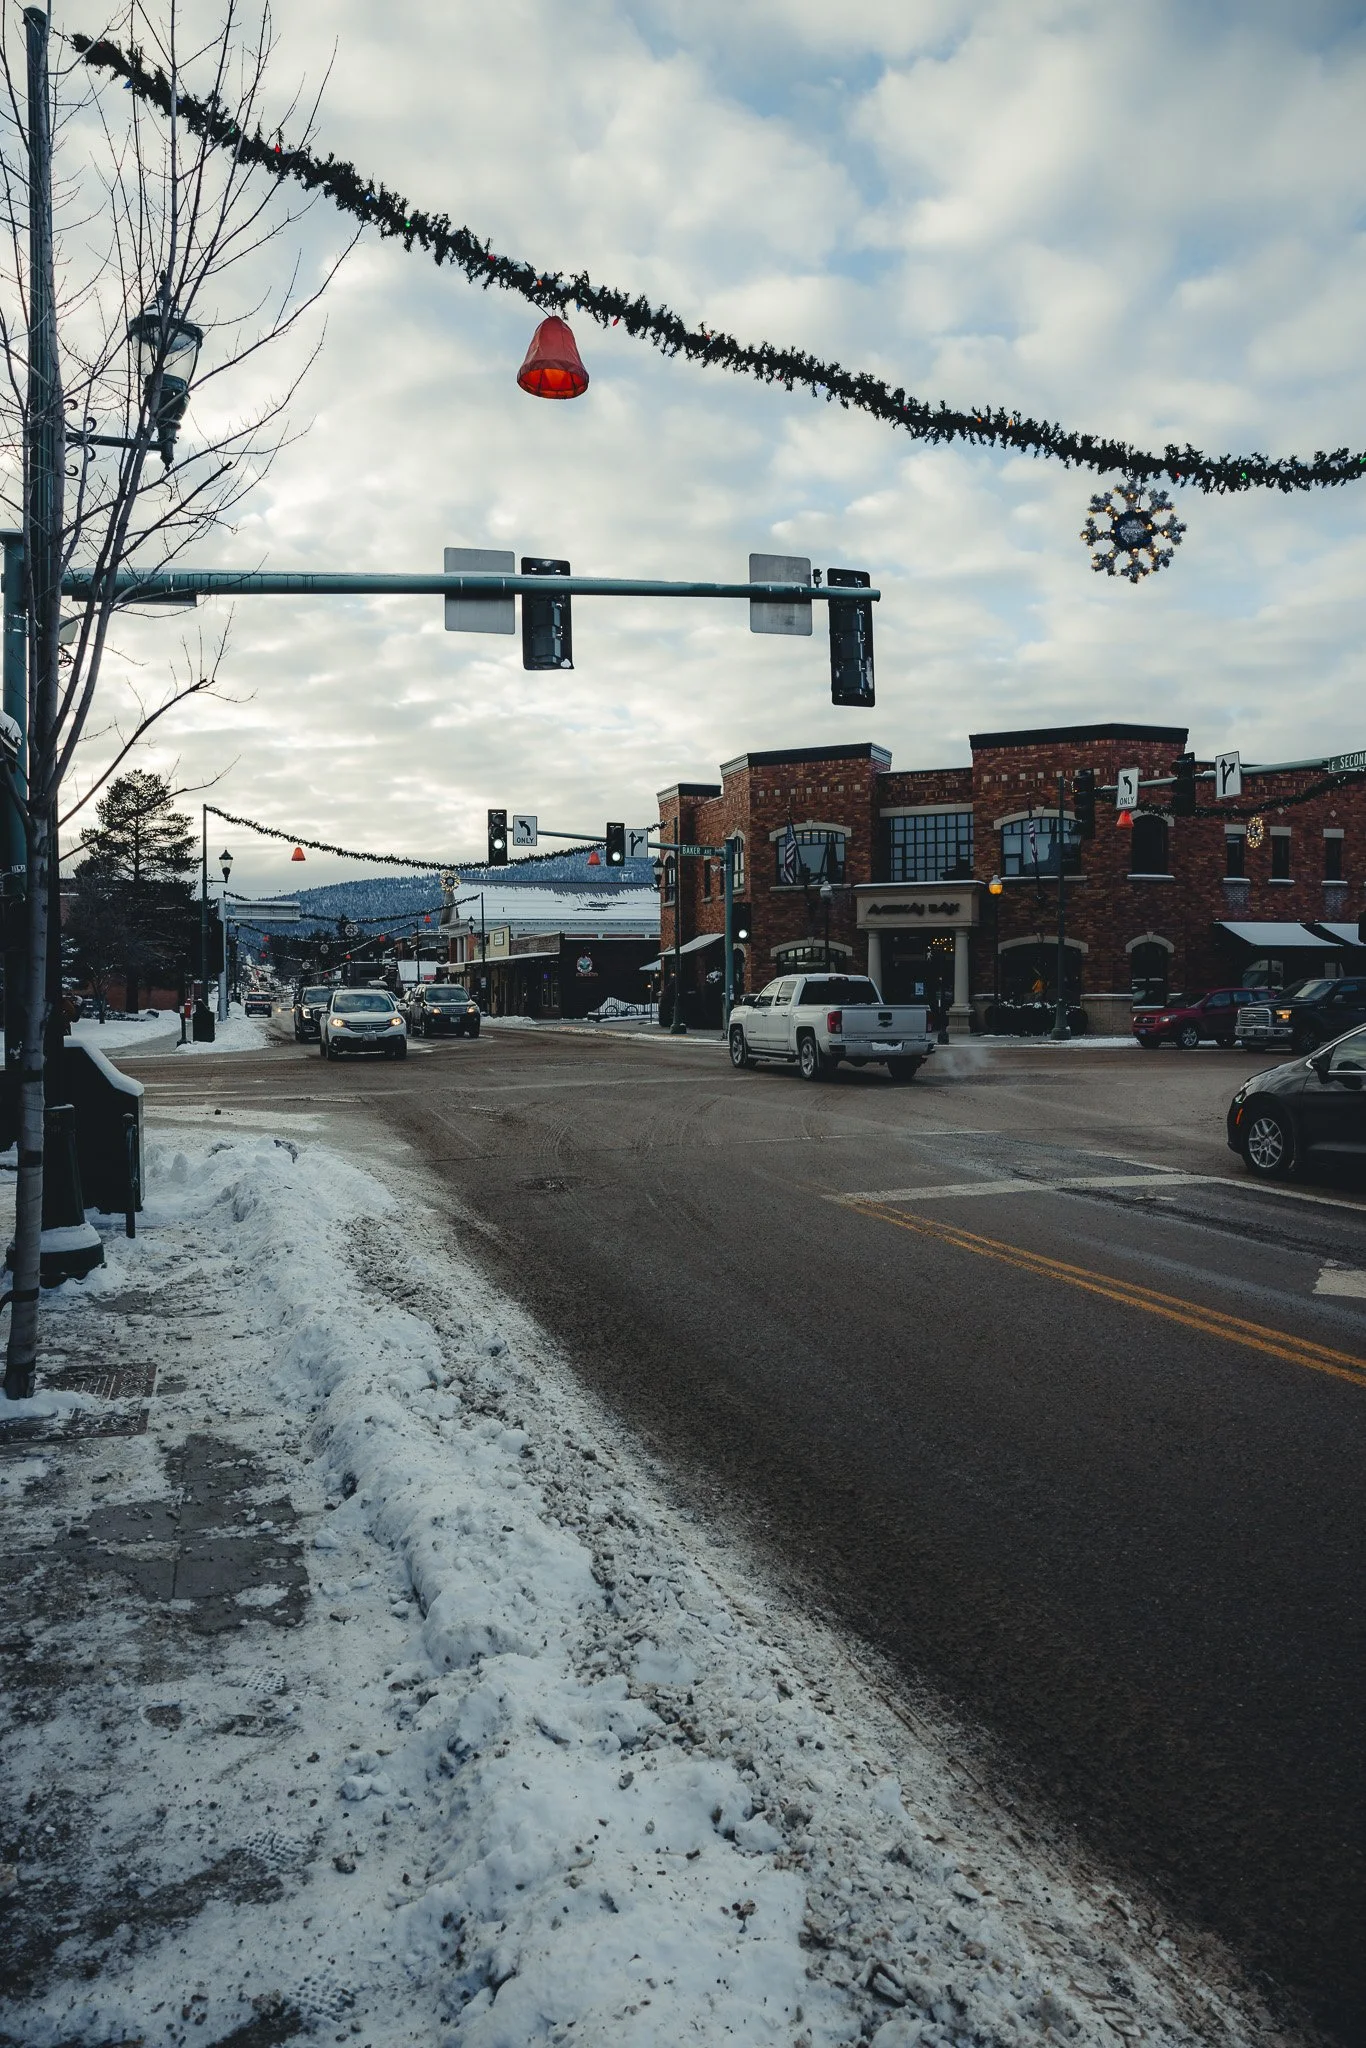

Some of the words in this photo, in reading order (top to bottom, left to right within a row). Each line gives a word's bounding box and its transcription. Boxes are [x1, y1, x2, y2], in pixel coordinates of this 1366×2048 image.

[1331, 761, 1335, 771] E
[1340, 752, 1366, 769] SECON
[1119, 796, 1135, 806] ONLY
[516, 836, 535, 844] ONLY
[682, 846, 701, 855] BAKER
